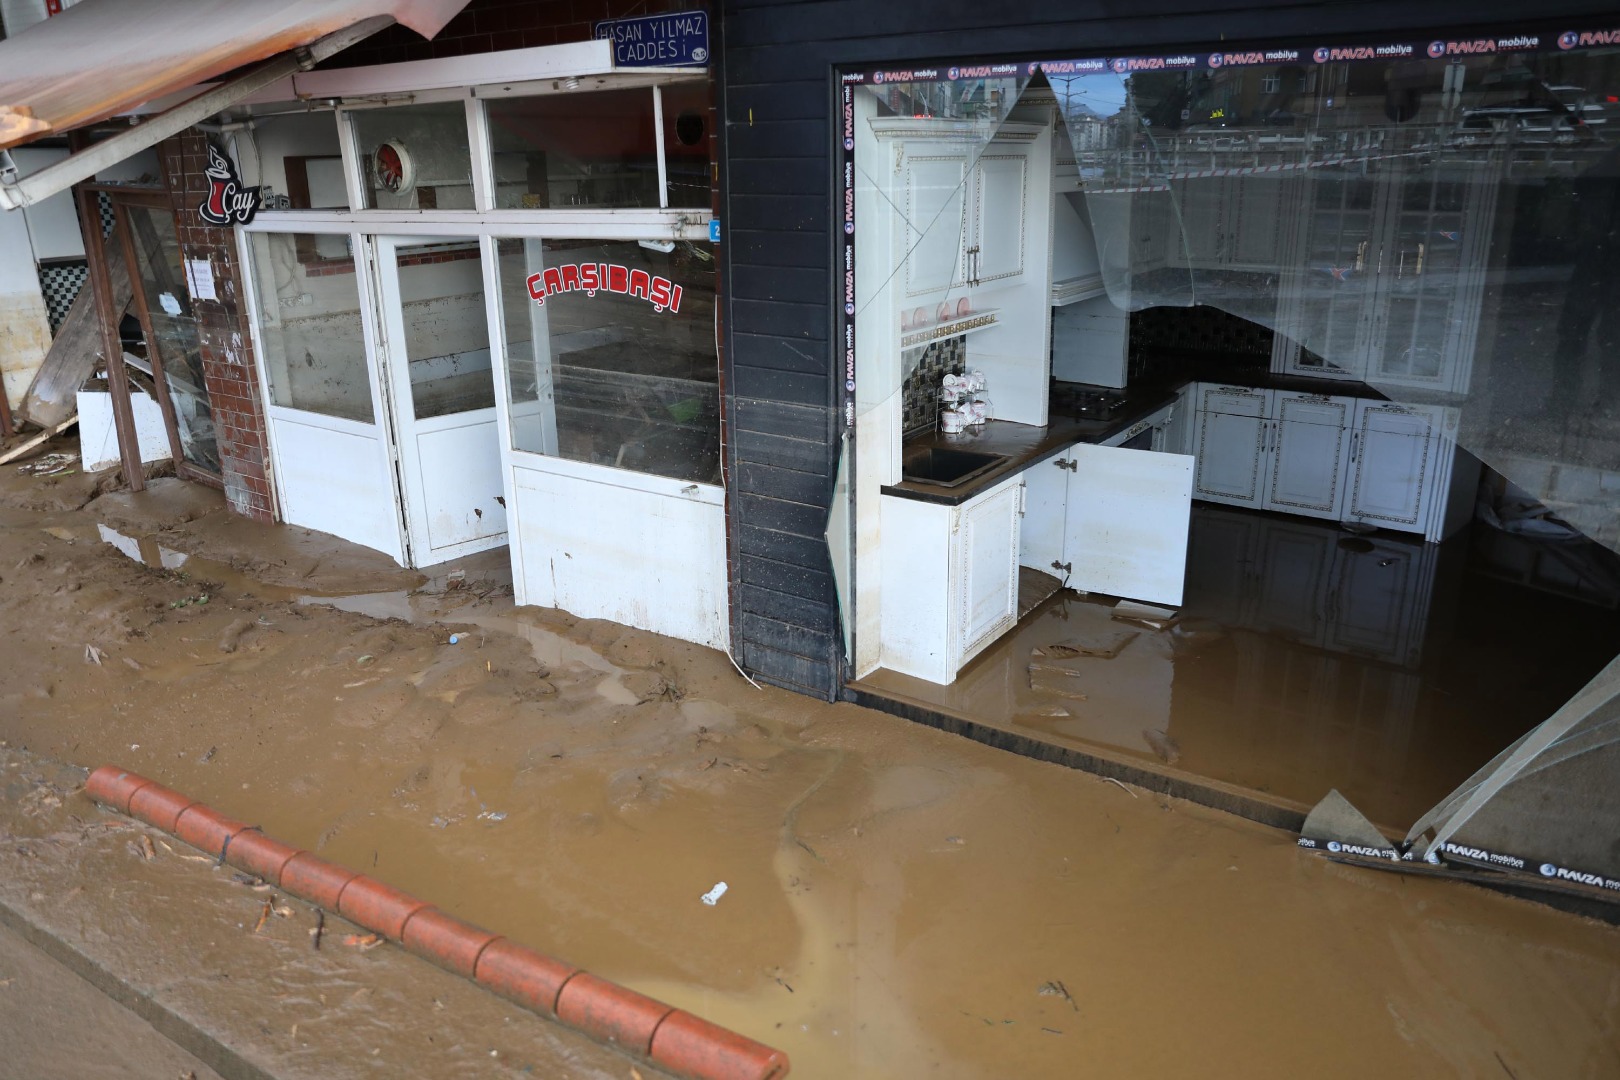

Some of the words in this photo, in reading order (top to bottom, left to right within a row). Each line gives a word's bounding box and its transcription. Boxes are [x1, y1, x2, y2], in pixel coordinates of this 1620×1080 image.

[600, 24, 642, 43] HASAN
[649, 17, 703, 39] YILMAZ
[1330, 47, 1375, 60] RAVZA
[1376, 44, 1412, 55] mobilya
[1446, 39, 1496, 54] RAVZA
[1498, 36, 1539, 47] mobilya
[1041, 62, 1075, 73] RAVZA
[1075, 60, 1103, 70] mobilya
[1127, 58, 1165, 70] RAVZA
[1166, 56, 1196, 66] mobilya
[1223, 52, 1264, 65] RAVZA
[1265, 50, 1298, 61] mobilya
[842, 73, 864, 82] mobilya
[884, 71, 914, 82] RAVZA
[914, 69, 937, 79] mobilya
[960, 67, 991, 78] RAVZA
[992, 64, 1017, 74] mobilya
[845, 103, 853, 137] RAVZA
[222, 182, 255, 224] Çay
[845, 188, 853, 222] RAVZA
[845, 244, 853, 270] mobilya
[526, 263, 683, 313] ÇARŞIBAŞI
[845, 270, 854, 303] RAVZA
[846, 348, 854, 380] RAVZA
[1341, 844, 1380, 857] RAVZA
[1446, 843, 1489, 861] RAVZA
[1490, 853, 1524, 867] mobilya
[1557, 868, 1603, 887] RAVZA
